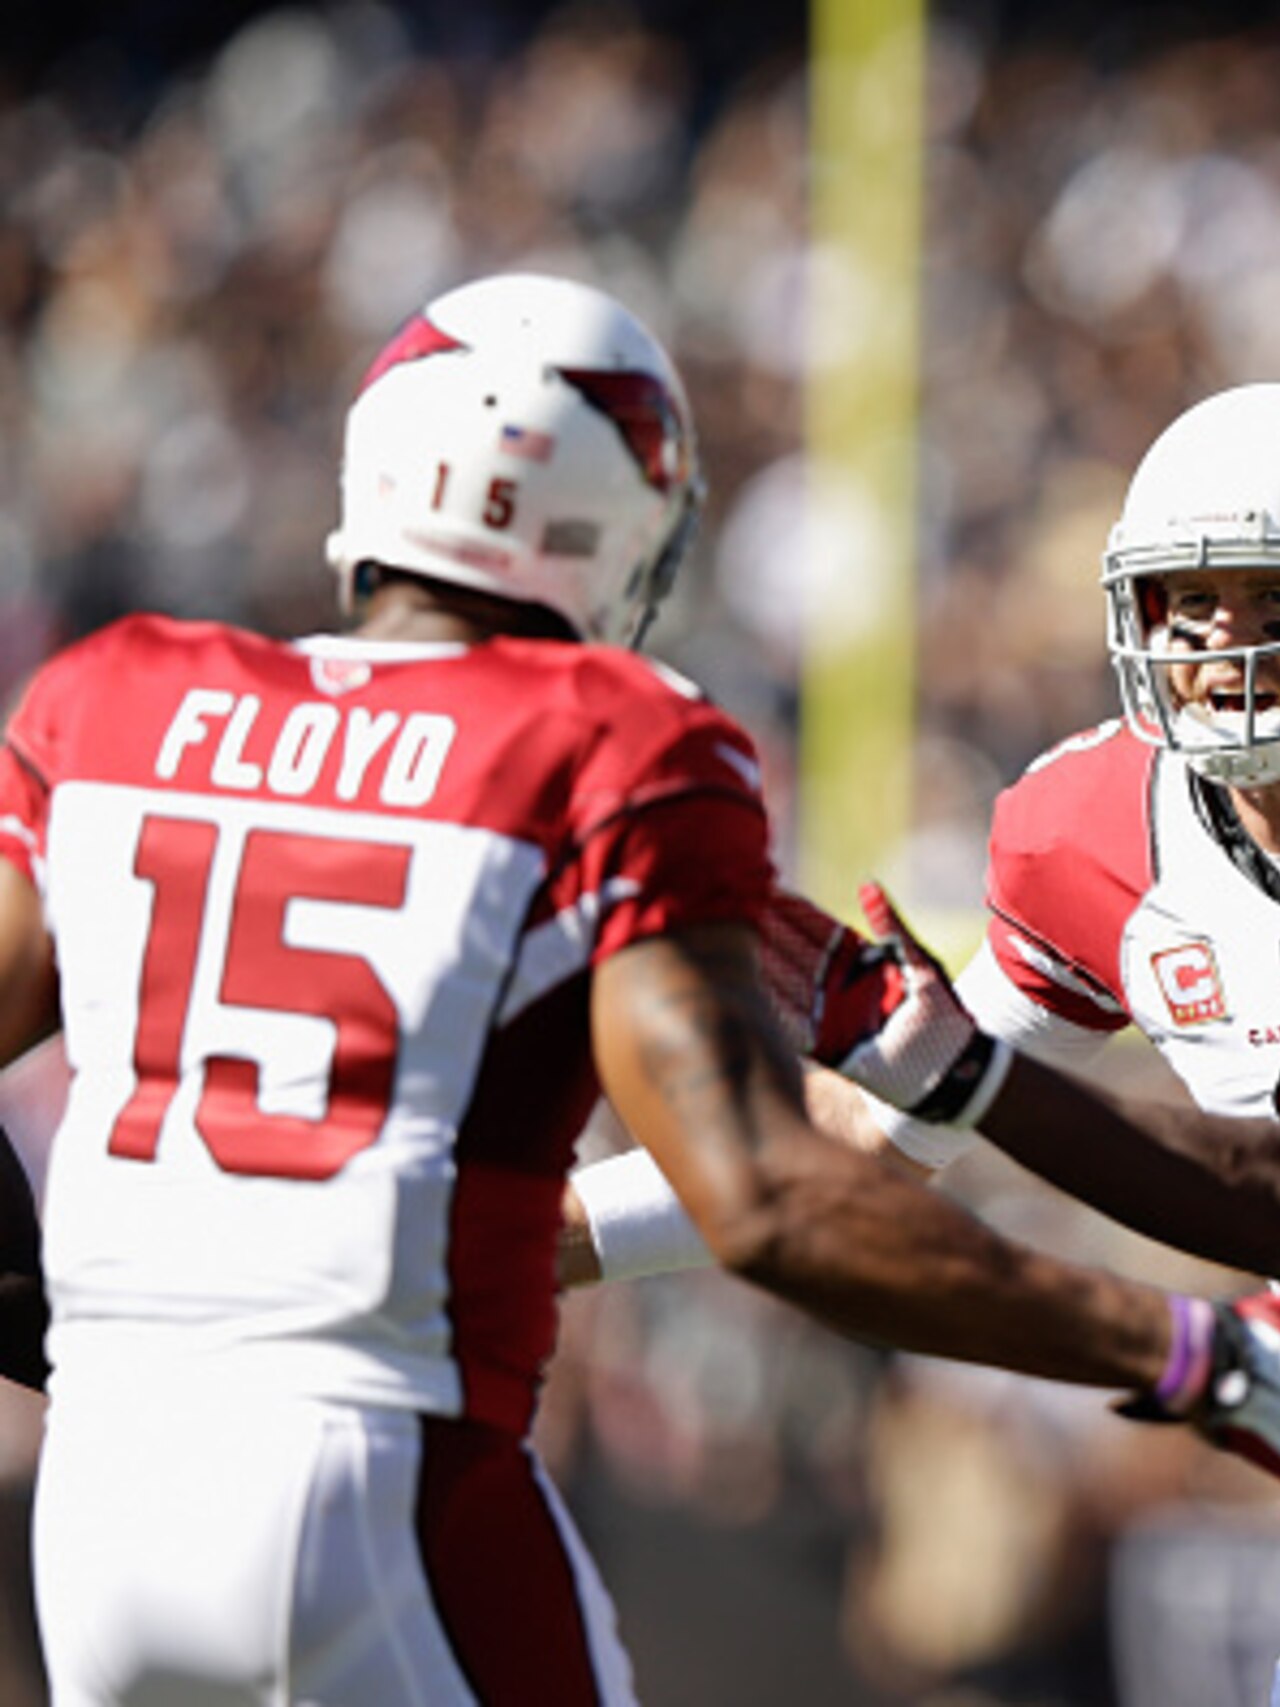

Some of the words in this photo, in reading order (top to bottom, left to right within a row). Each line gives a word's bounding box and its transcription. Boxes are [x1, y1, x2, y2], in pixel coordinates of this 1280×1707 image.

[155, 688, 456, 807] FLOYD
[107, 813, 414, 1183] 15
[1157, 949, 1214, 1005] C
